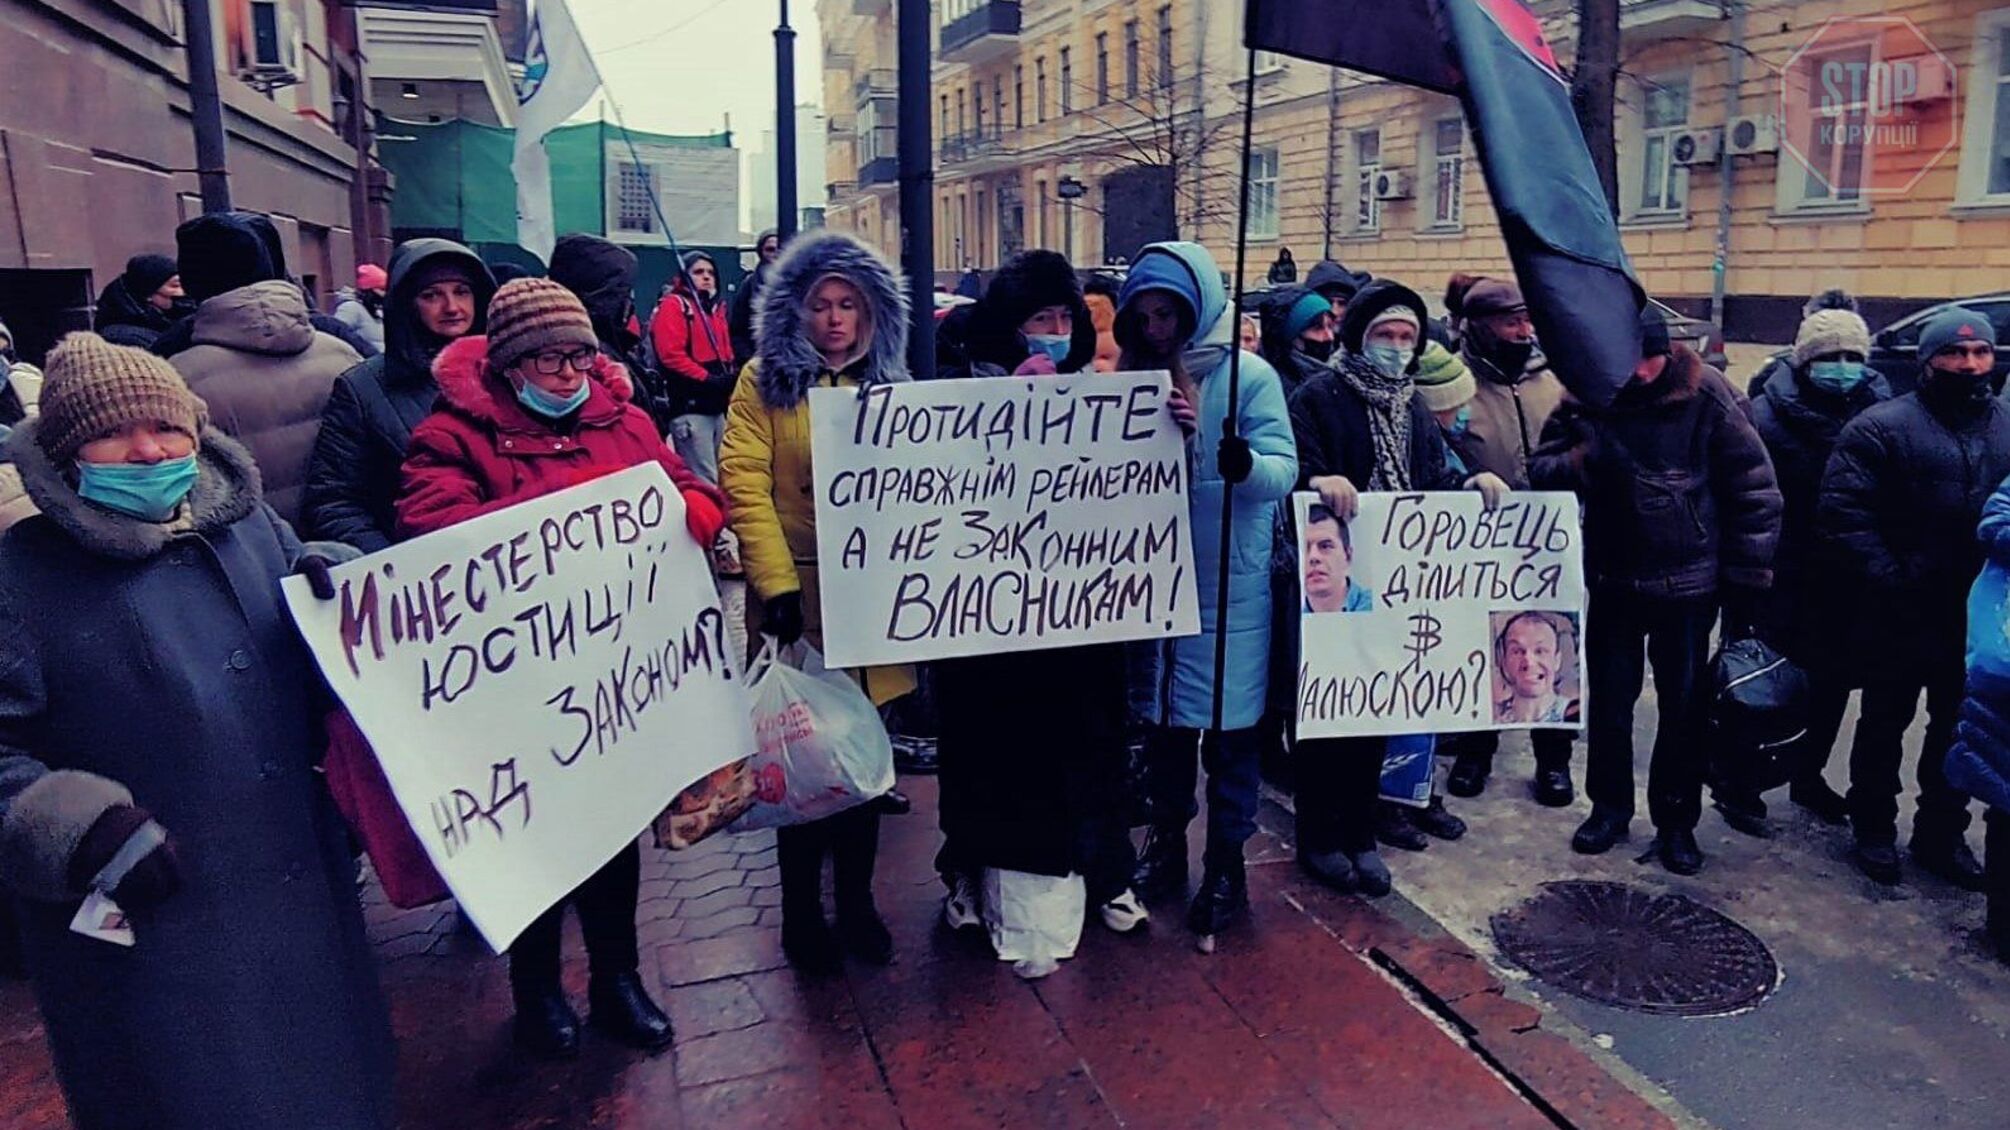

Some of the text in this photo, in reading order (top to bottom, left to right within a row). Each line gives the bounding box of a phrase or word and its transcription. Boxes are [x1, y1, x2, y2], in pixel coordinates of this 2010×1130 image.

[828, 456, 1015, 512] СПРАВЖНІМ
[842, 510, 1178, 572] А НЕ ЗАКОННИМ
[339, 485, 664, 677] МІНЕСТЕРСТВО
[421, 541, 668, 711] ЮСТИЦІЇ
[545, 606, 731, 767] ЗАКОНОМ?
